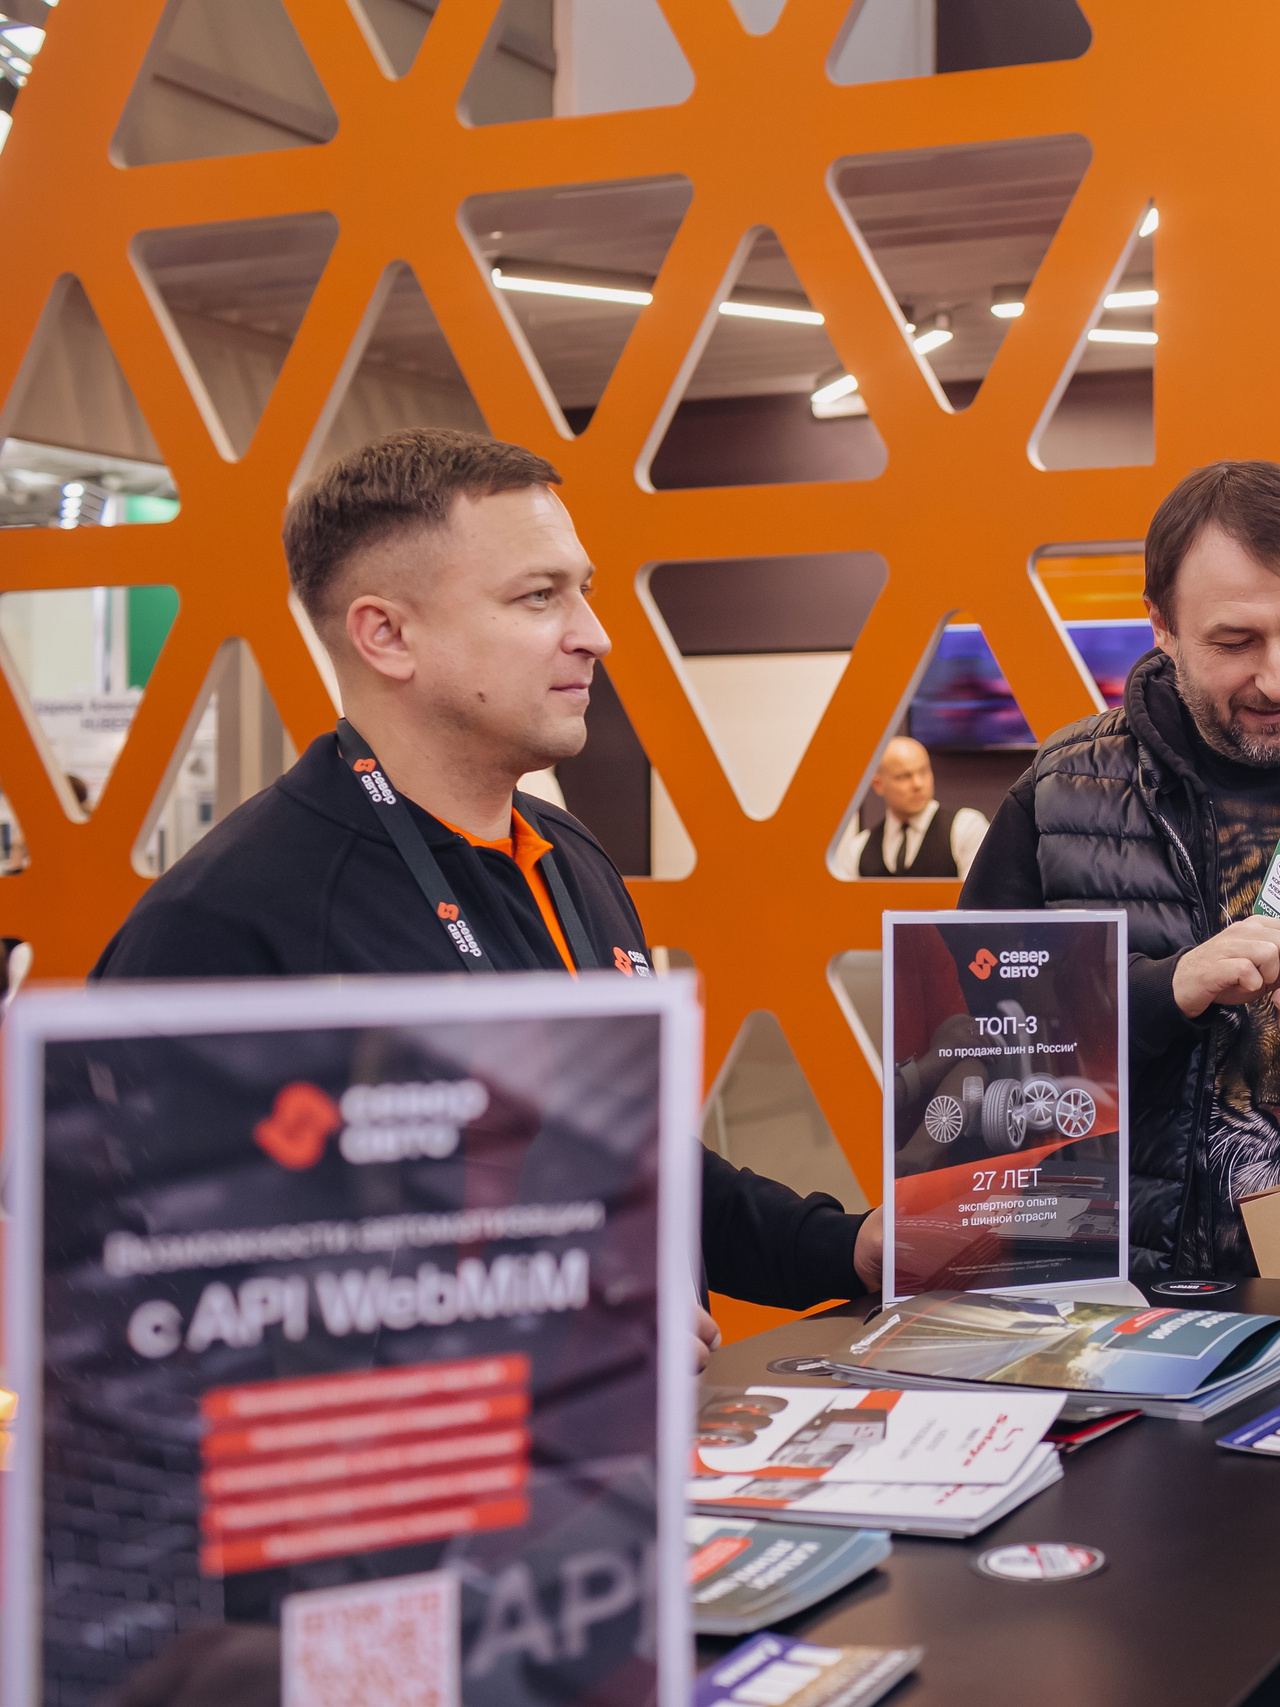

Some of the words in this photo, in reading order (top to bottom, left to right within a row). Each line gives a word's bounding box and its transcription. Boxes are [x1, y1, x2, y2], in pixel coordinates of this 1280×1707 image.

[361, 775, 382, 803] авто
[371, 770, 396, 805] север
[447, 923, 469, 953] авто
[456, 919, 482, 958] север
[999, 949, 1050, 965] север
[1000, 965, 1039, 979] авто
[975, 1016, 1038, 1037] ТОП-3
[939, 1047, 952, 1057] по
[954, 1045, 1002, 1059] продаже
[1004, 1044, 1026, 1055] шин
[1028, 1044, 1034, 1054] в
[972, 1171, 996, 1191] 27
[1001, 1168, 1042, 1188] ЛЕТ
[958, 1198, 1025, 1213] экспертного
[1028, 1197, 1058, 1209] опыта
[962, 1217, 968, 1226] в
[970, 1212, 1012, 1226] шинной
[1014, 1211, 1057, 1224] отрасли
